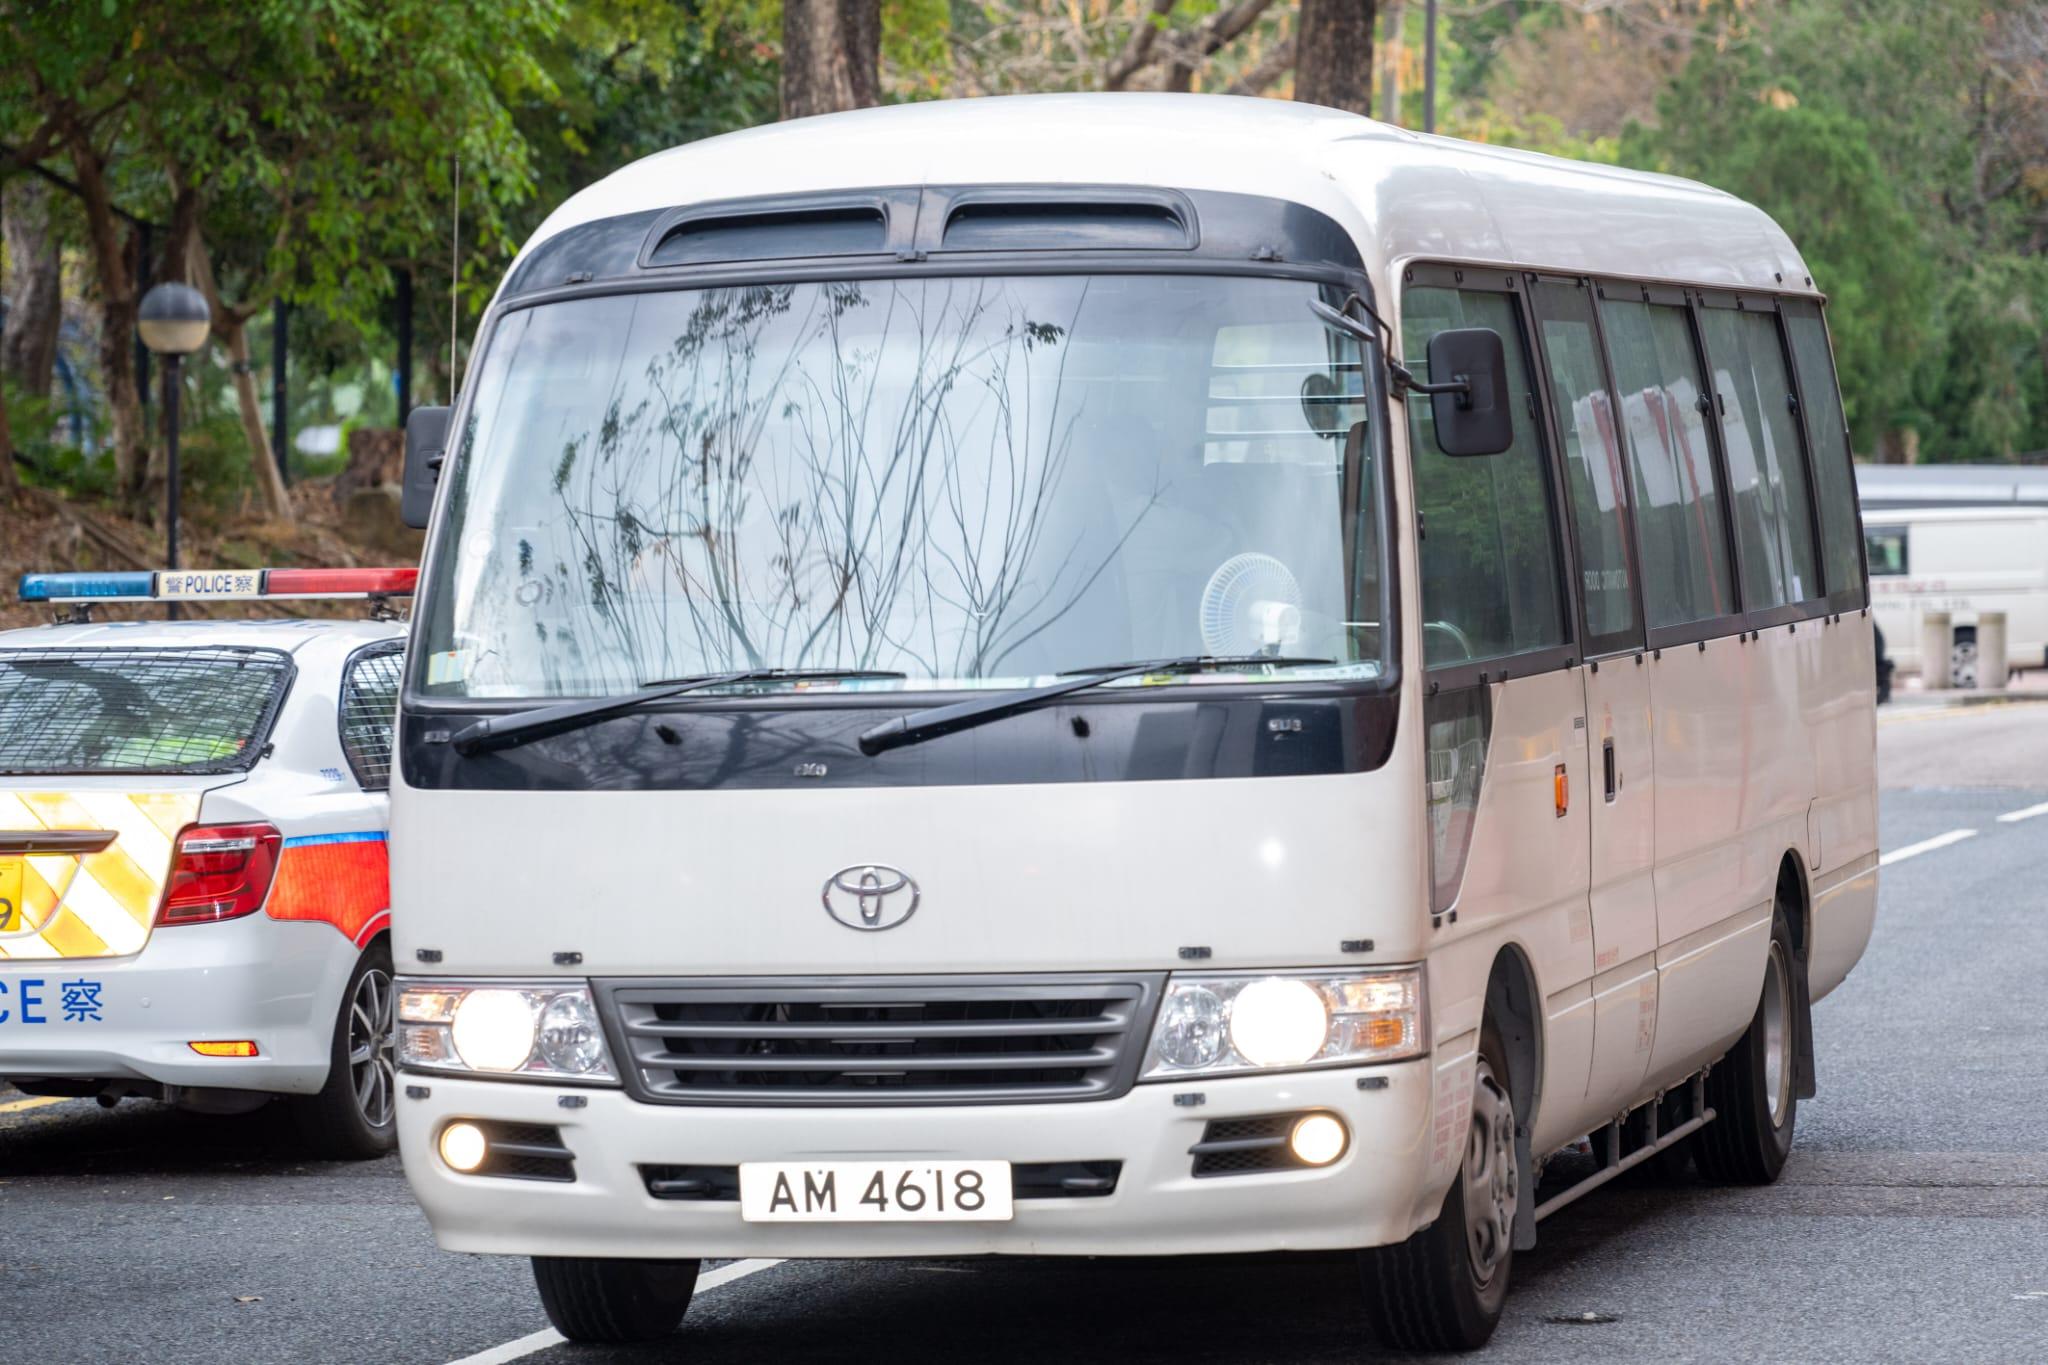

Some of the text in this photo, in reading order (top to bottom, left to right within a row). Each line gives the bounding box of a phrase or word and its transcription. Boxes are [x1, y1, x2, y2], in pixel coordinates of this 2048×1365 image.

[165, 575, 254, 593] 警 POLICE 察
[61, 978, 103, 1022] 察
[769, 1169, 986, 1213] AM 4618
